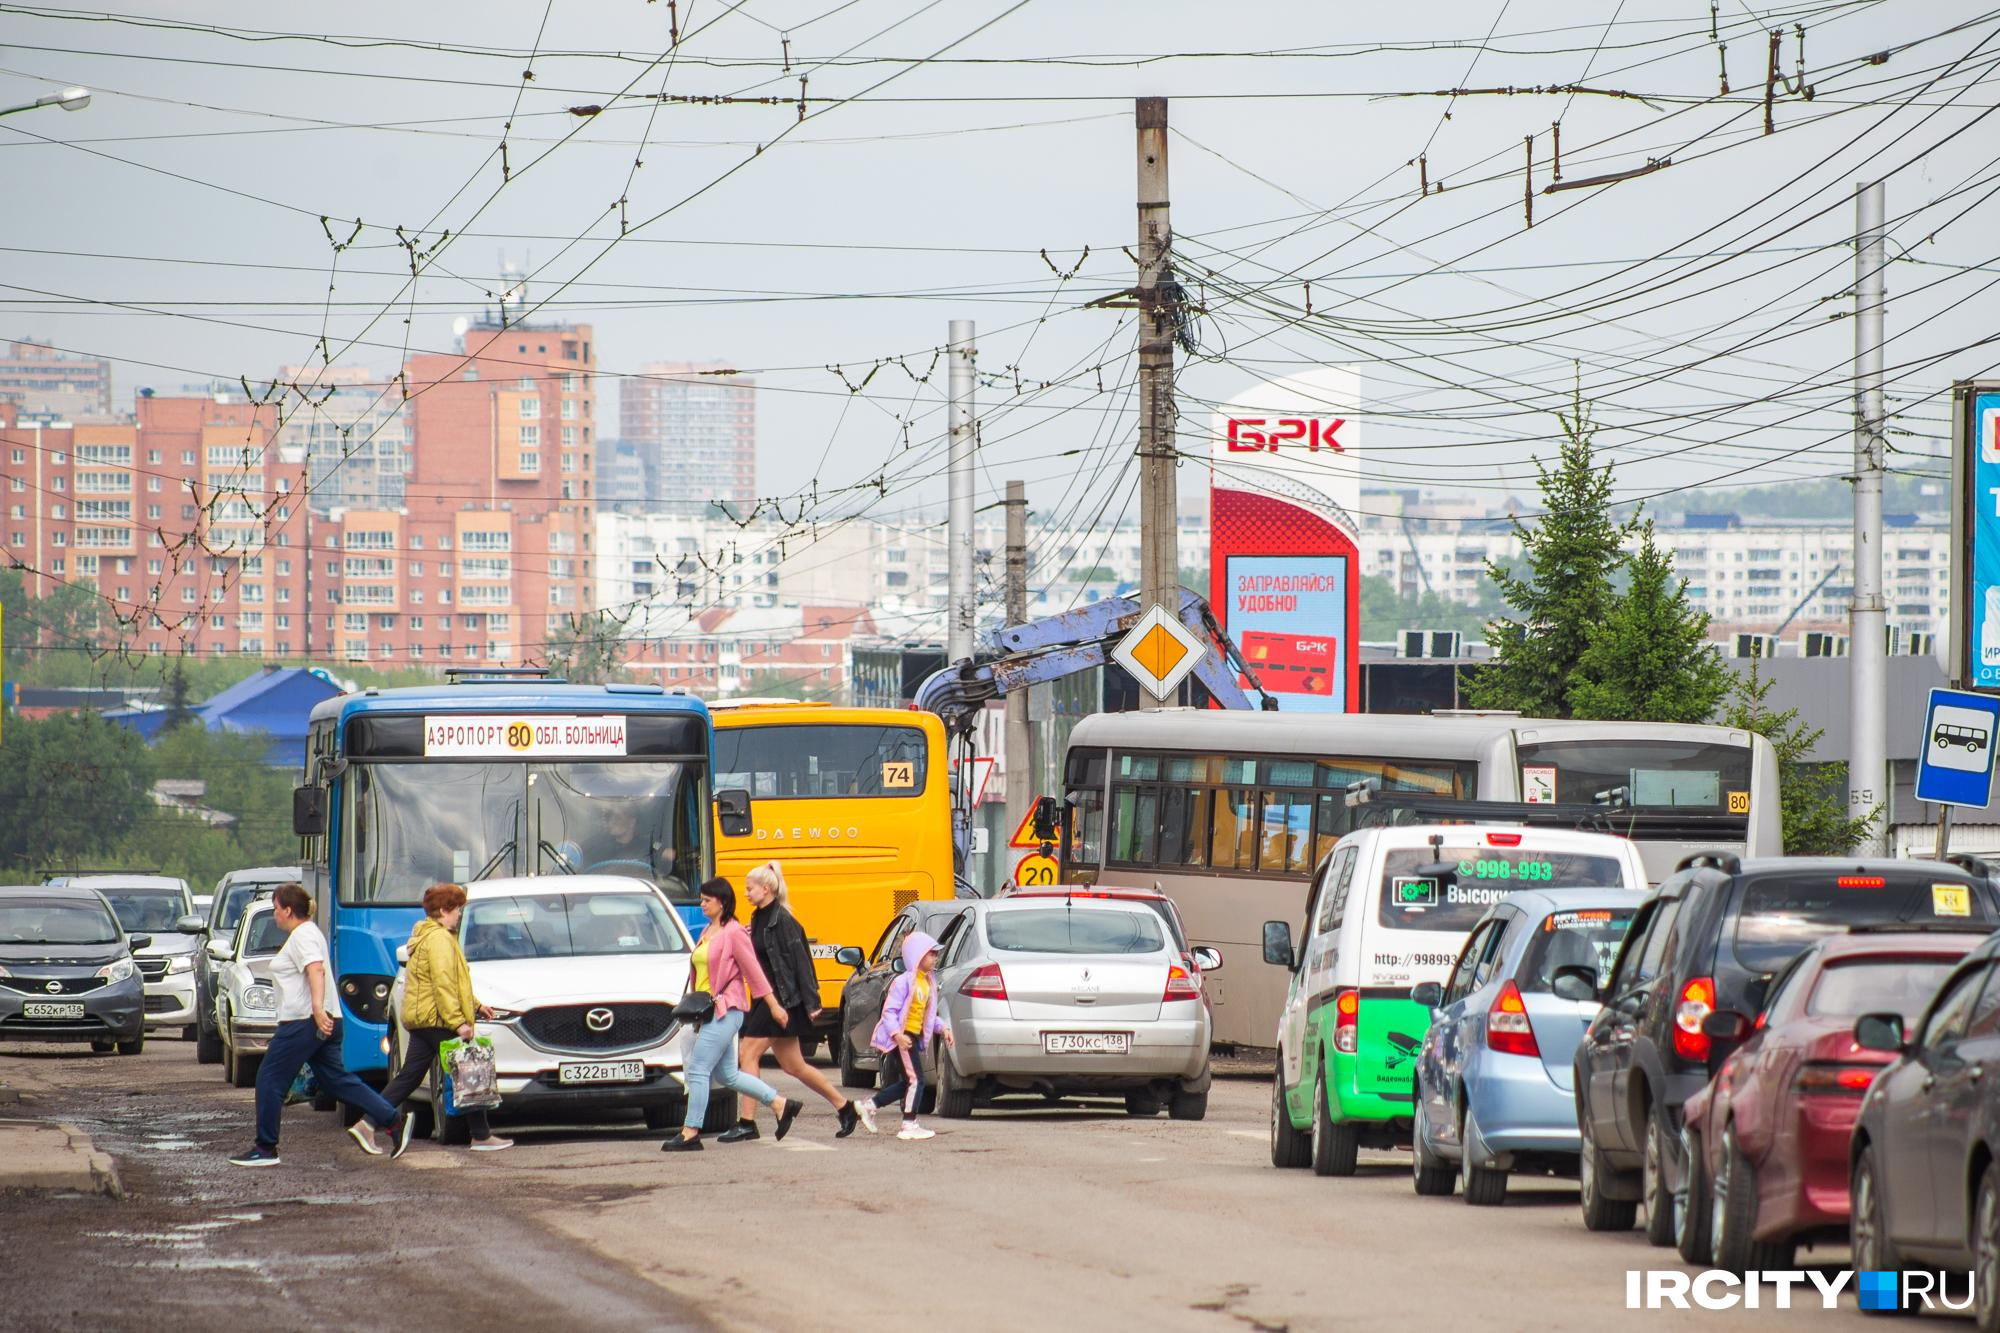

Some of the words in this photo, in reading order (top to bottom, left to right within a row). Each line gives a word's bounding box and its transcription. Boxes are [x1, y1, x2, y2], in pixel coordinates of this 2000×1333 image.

[1238, 573, 1335, 592] ЗАПРАВЛЯЙСЯ
[1238, 595, 1297, 613] УДОБНО!
[427, 726, 503, 746] АЭРОПОРТ
[508, 725, 531, 747] 80
[536, 726, 562, 745] ОБЛ.
[565, 726, 624, 748] БОЛЬНИЦА
[887, 767, 910, 783] 74
[1731, 795, 1746, 810] 80
[757, 826, 859, 840] DAEWOO
[1476, 859, 1552, 881] 998-993
[67, 1005, 82, 1013] 138
[1104, 1035, 1123, 1045] 138
[620, 1063, 640, 1074] 138
